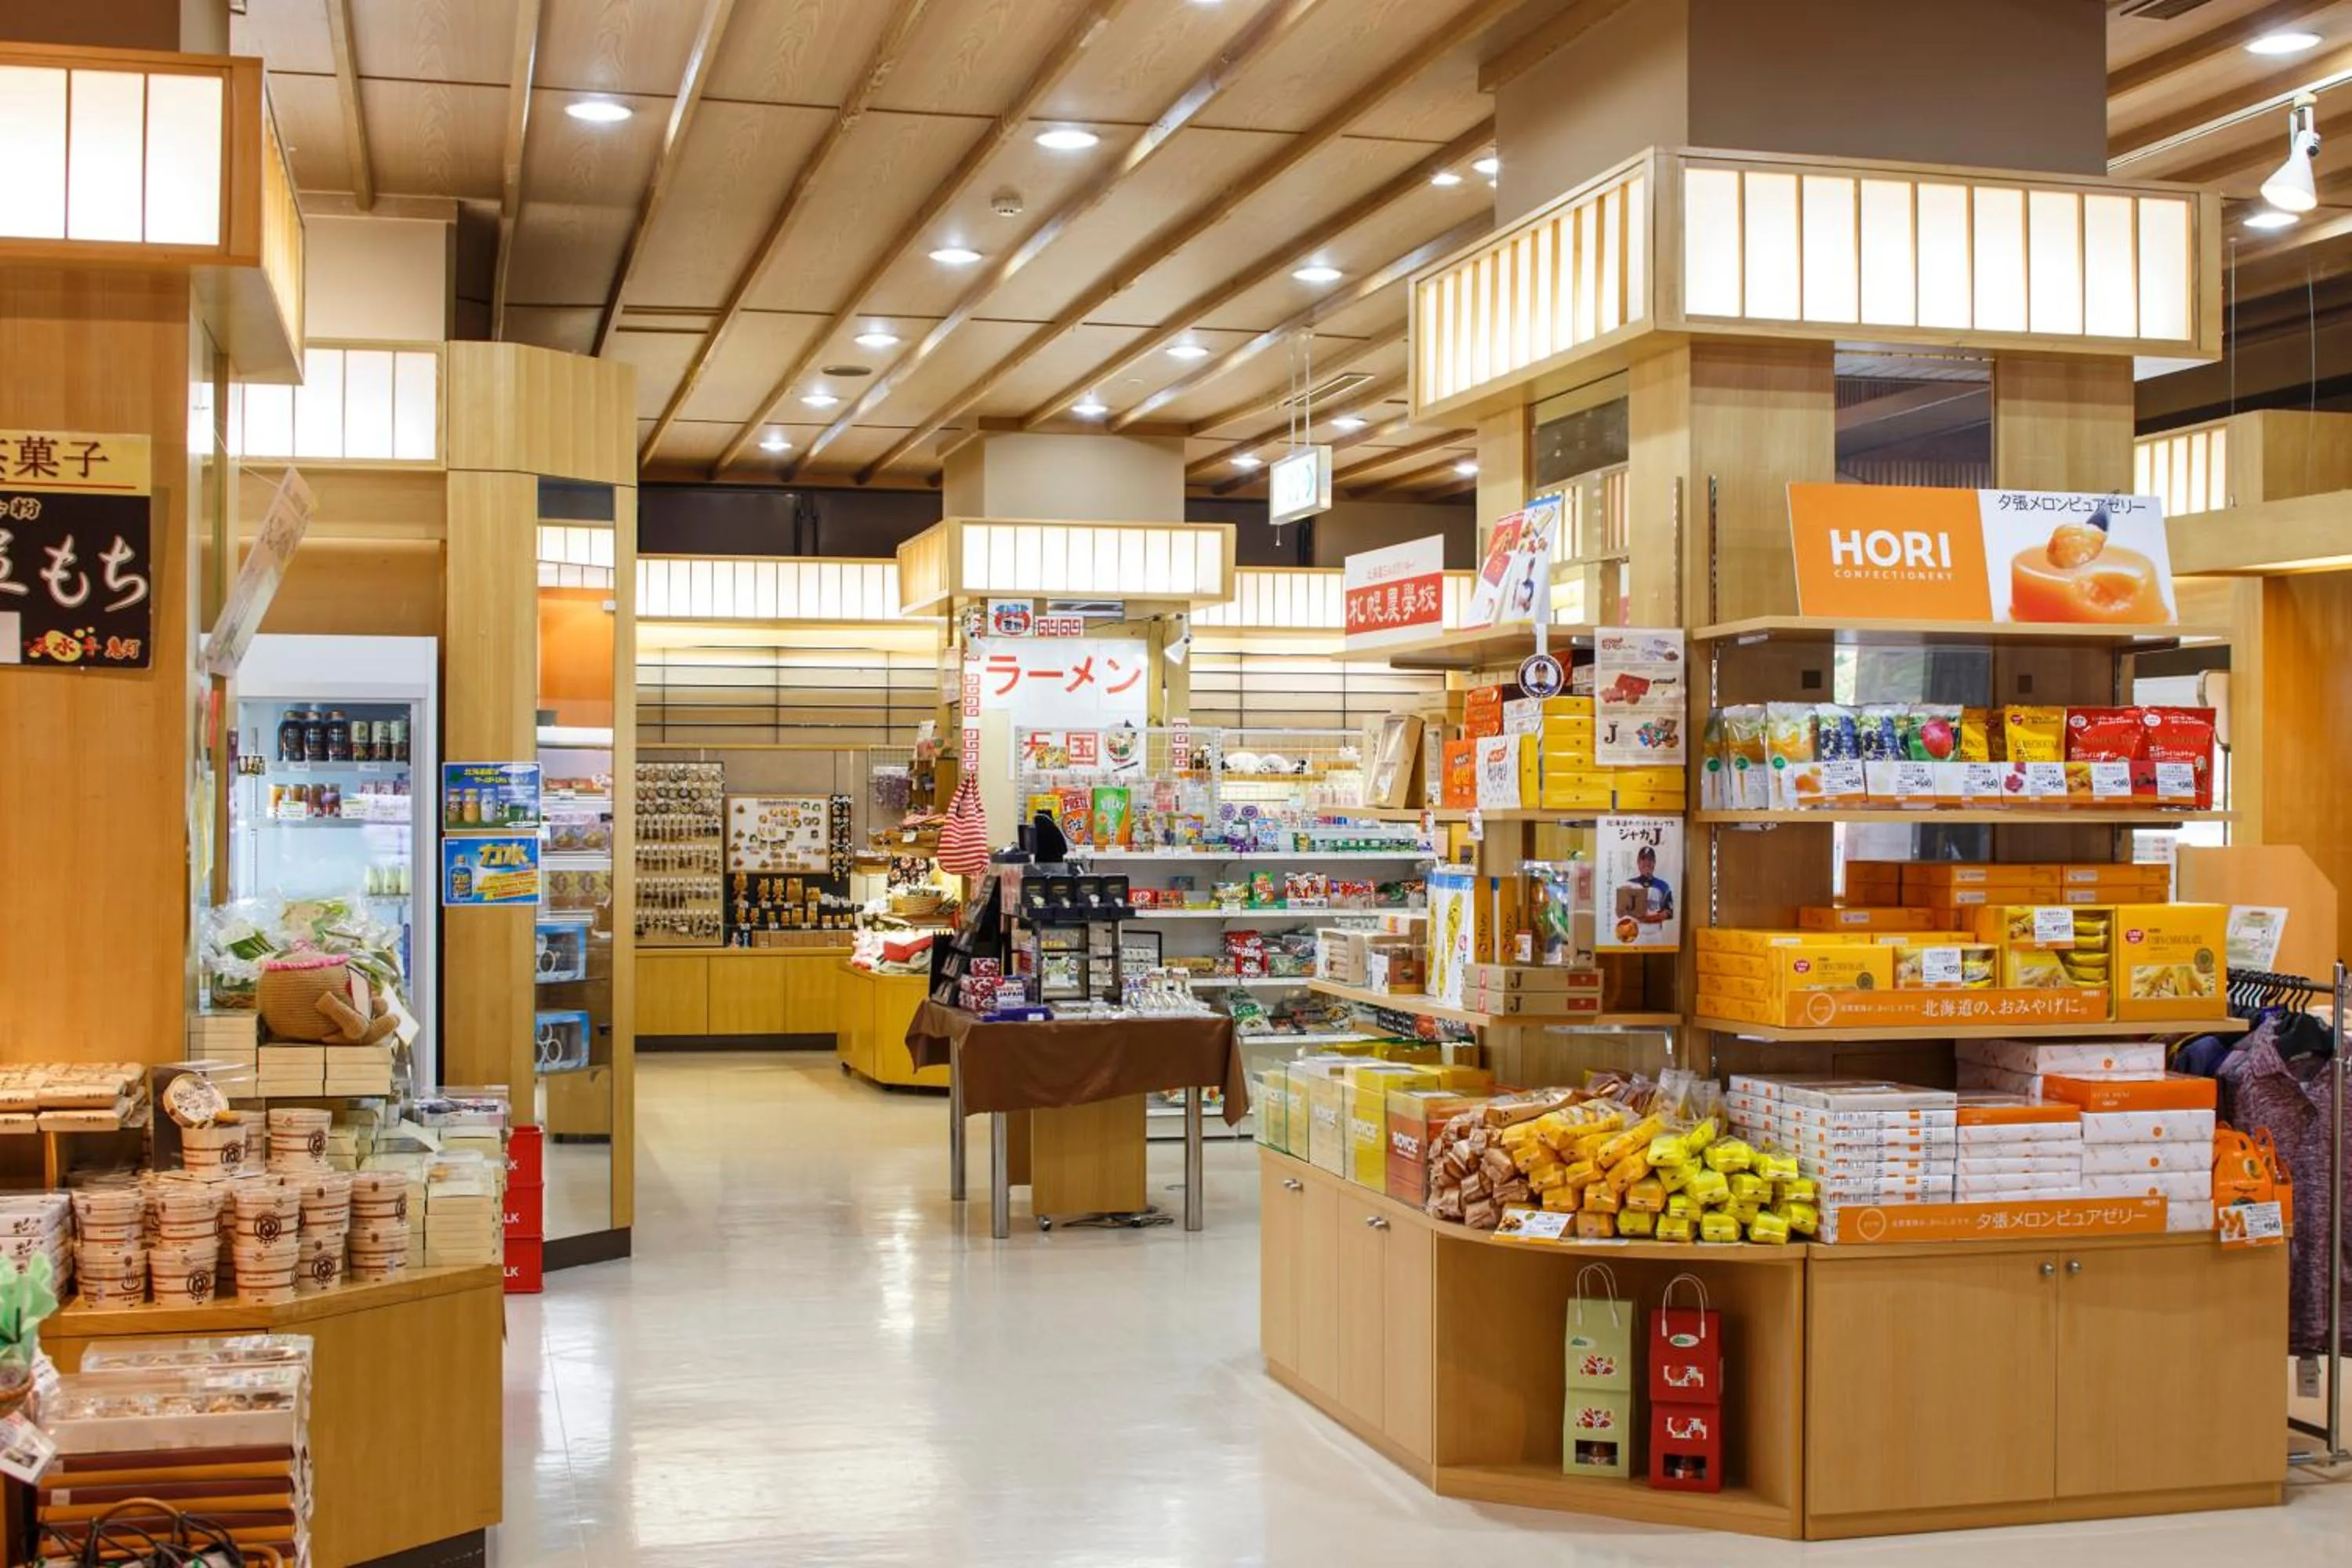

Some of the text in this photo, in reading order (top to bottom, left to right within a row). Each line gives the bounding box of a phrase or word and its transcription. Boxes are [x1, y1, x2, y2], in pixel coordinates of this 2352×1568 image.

[1998, 494, 2147, 514] 夕張メロンピュアゼリー
[1830, 529, 1952, 568] HORI
[1834, 569, 1954, 580] CONFECTIONERY
[985, 656, 1142, 695] ラーメン
[1922, 998, 2088, 1017] 北海道の、おみやげに。
[1976, 1208, 2148, 1230] 夕張メロンピュアゼリー
